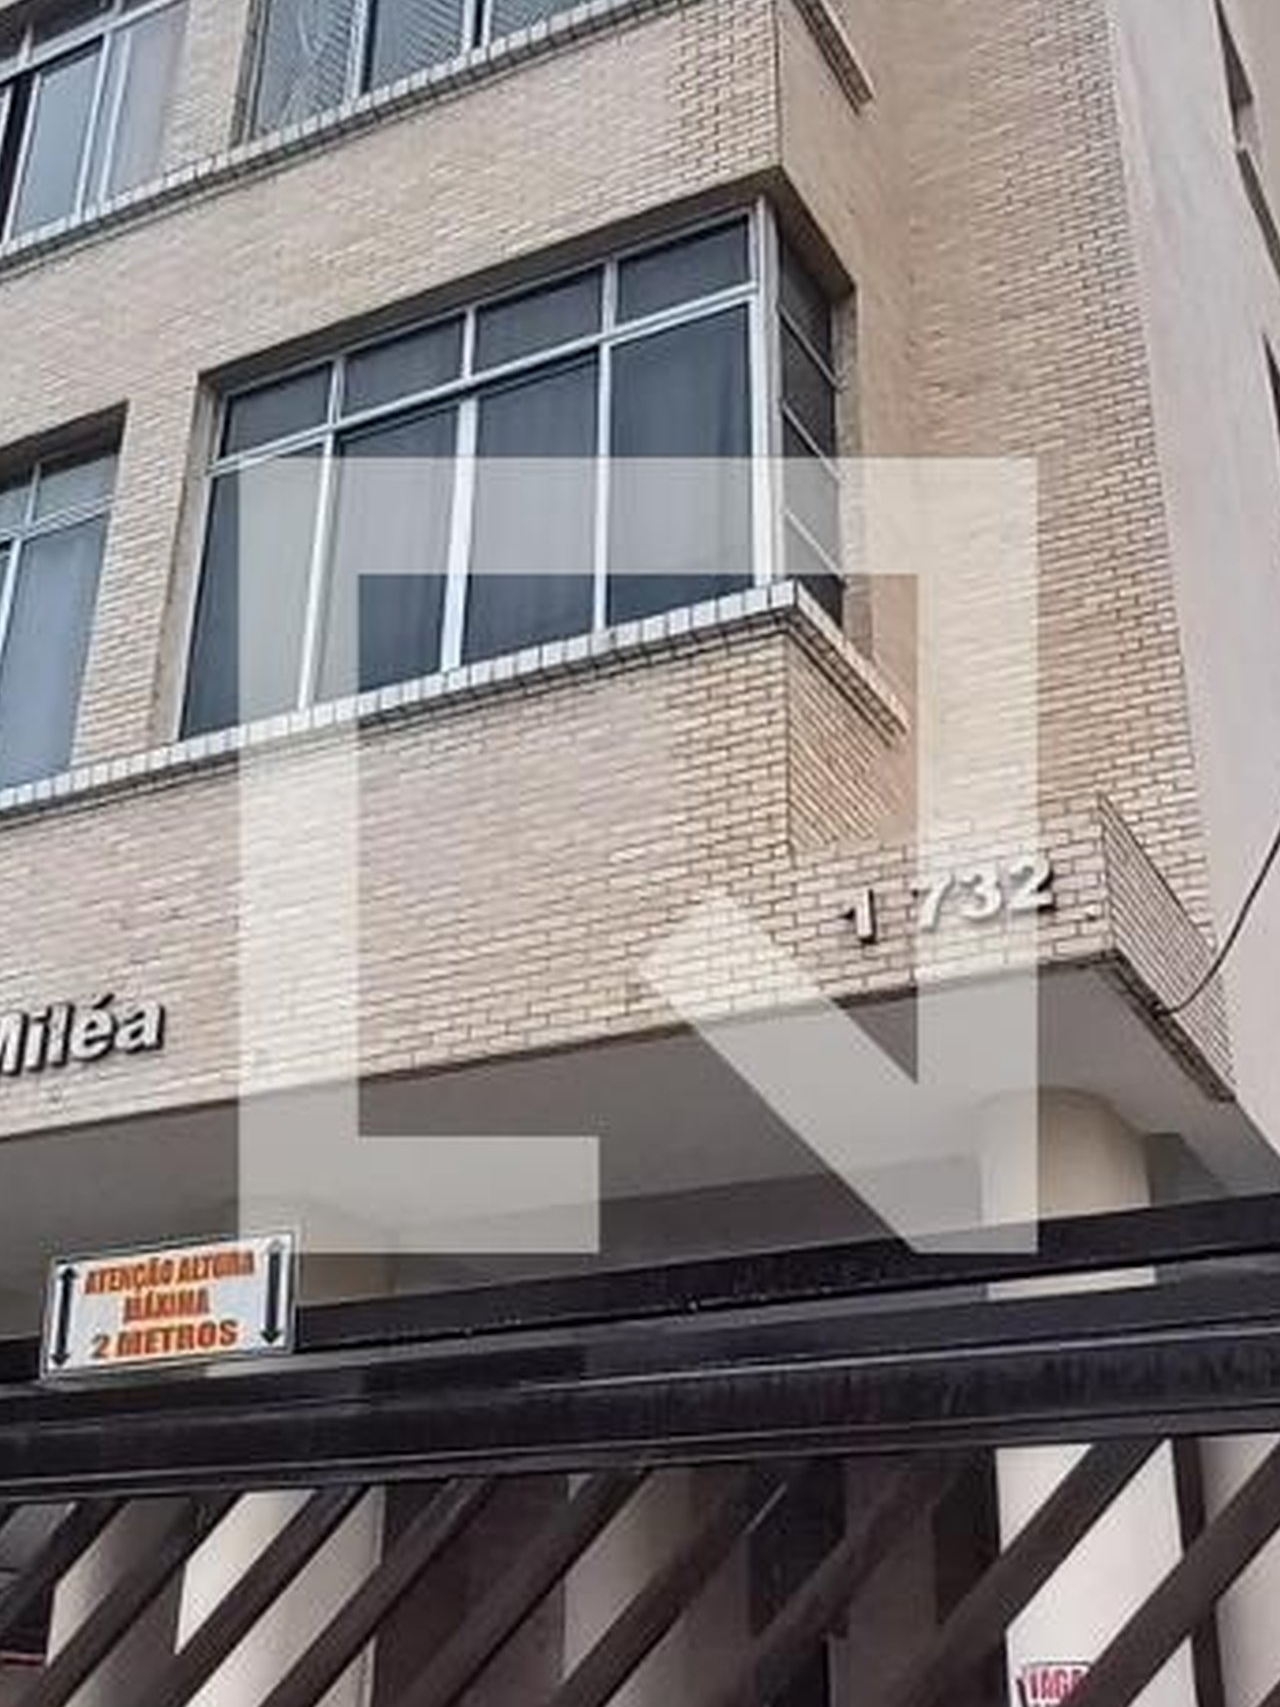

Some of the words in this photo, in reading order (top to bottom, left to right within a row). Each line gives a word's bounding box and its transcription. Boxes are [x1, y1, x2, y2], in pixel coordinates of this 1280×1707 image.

[84, 1256, 174, 1295] ATENÇÃO
[177, 1250, 255, 1284] ALTURA
[122, 1287, 210, 1324] MÁXIMA
[91, 1333, 111, 1359] 2
[116, 1318, 239, 1358] METROS
